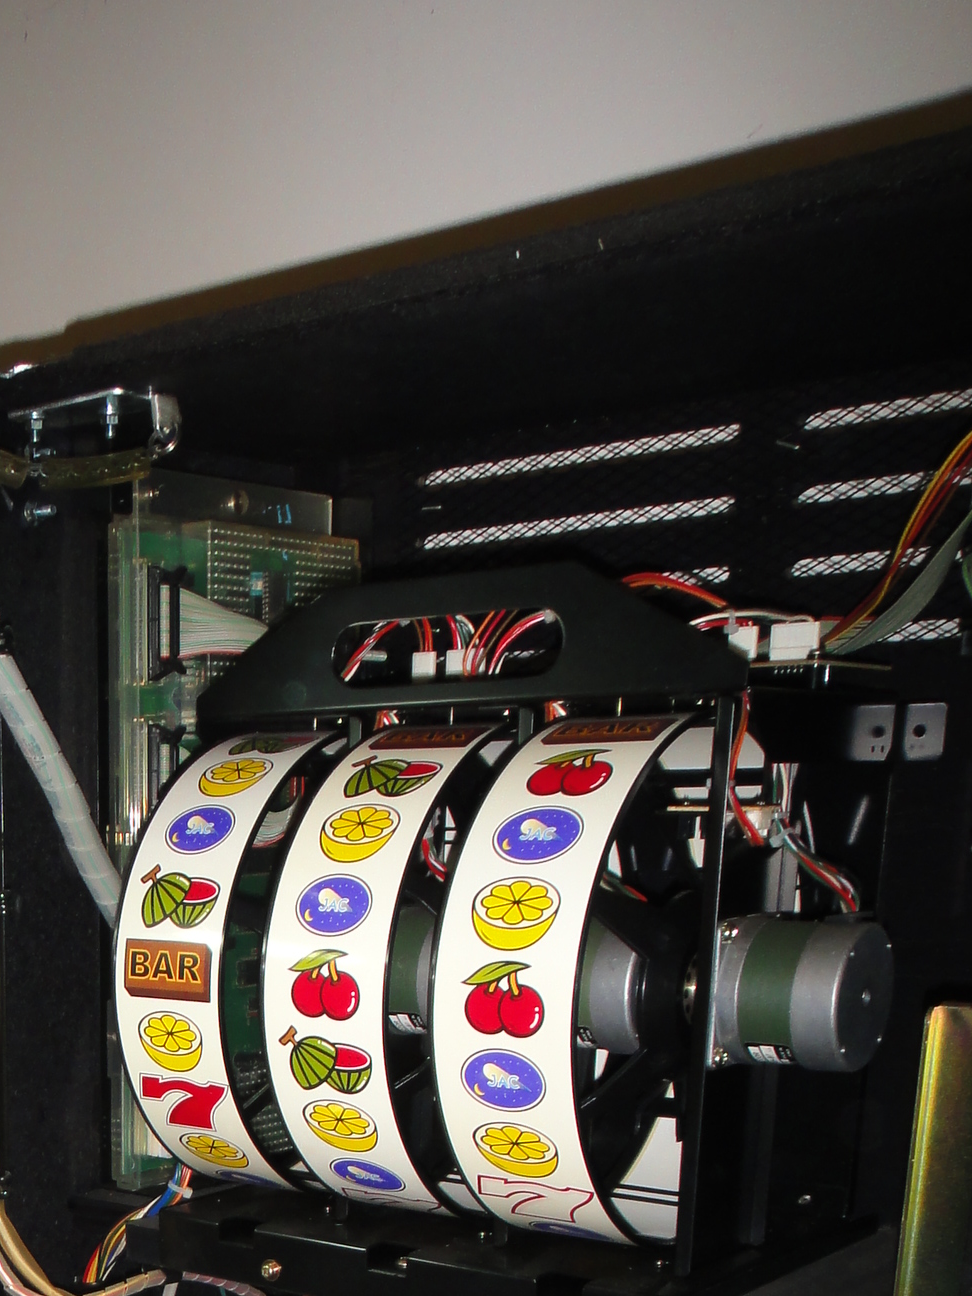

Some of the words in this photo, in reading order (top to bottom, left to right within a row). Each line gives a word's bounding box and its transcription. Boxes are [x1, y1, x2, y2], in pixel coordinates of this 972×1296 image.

[185, 822, 215, 835] JAC
[518, 826, 556, 842] JAC
[318, 898, 350, 913] JAC
[128, 948, 202, 984] BAR
[487, 1073, 521, 1090] JAC
[139, 1072, 230, 1131] 7
